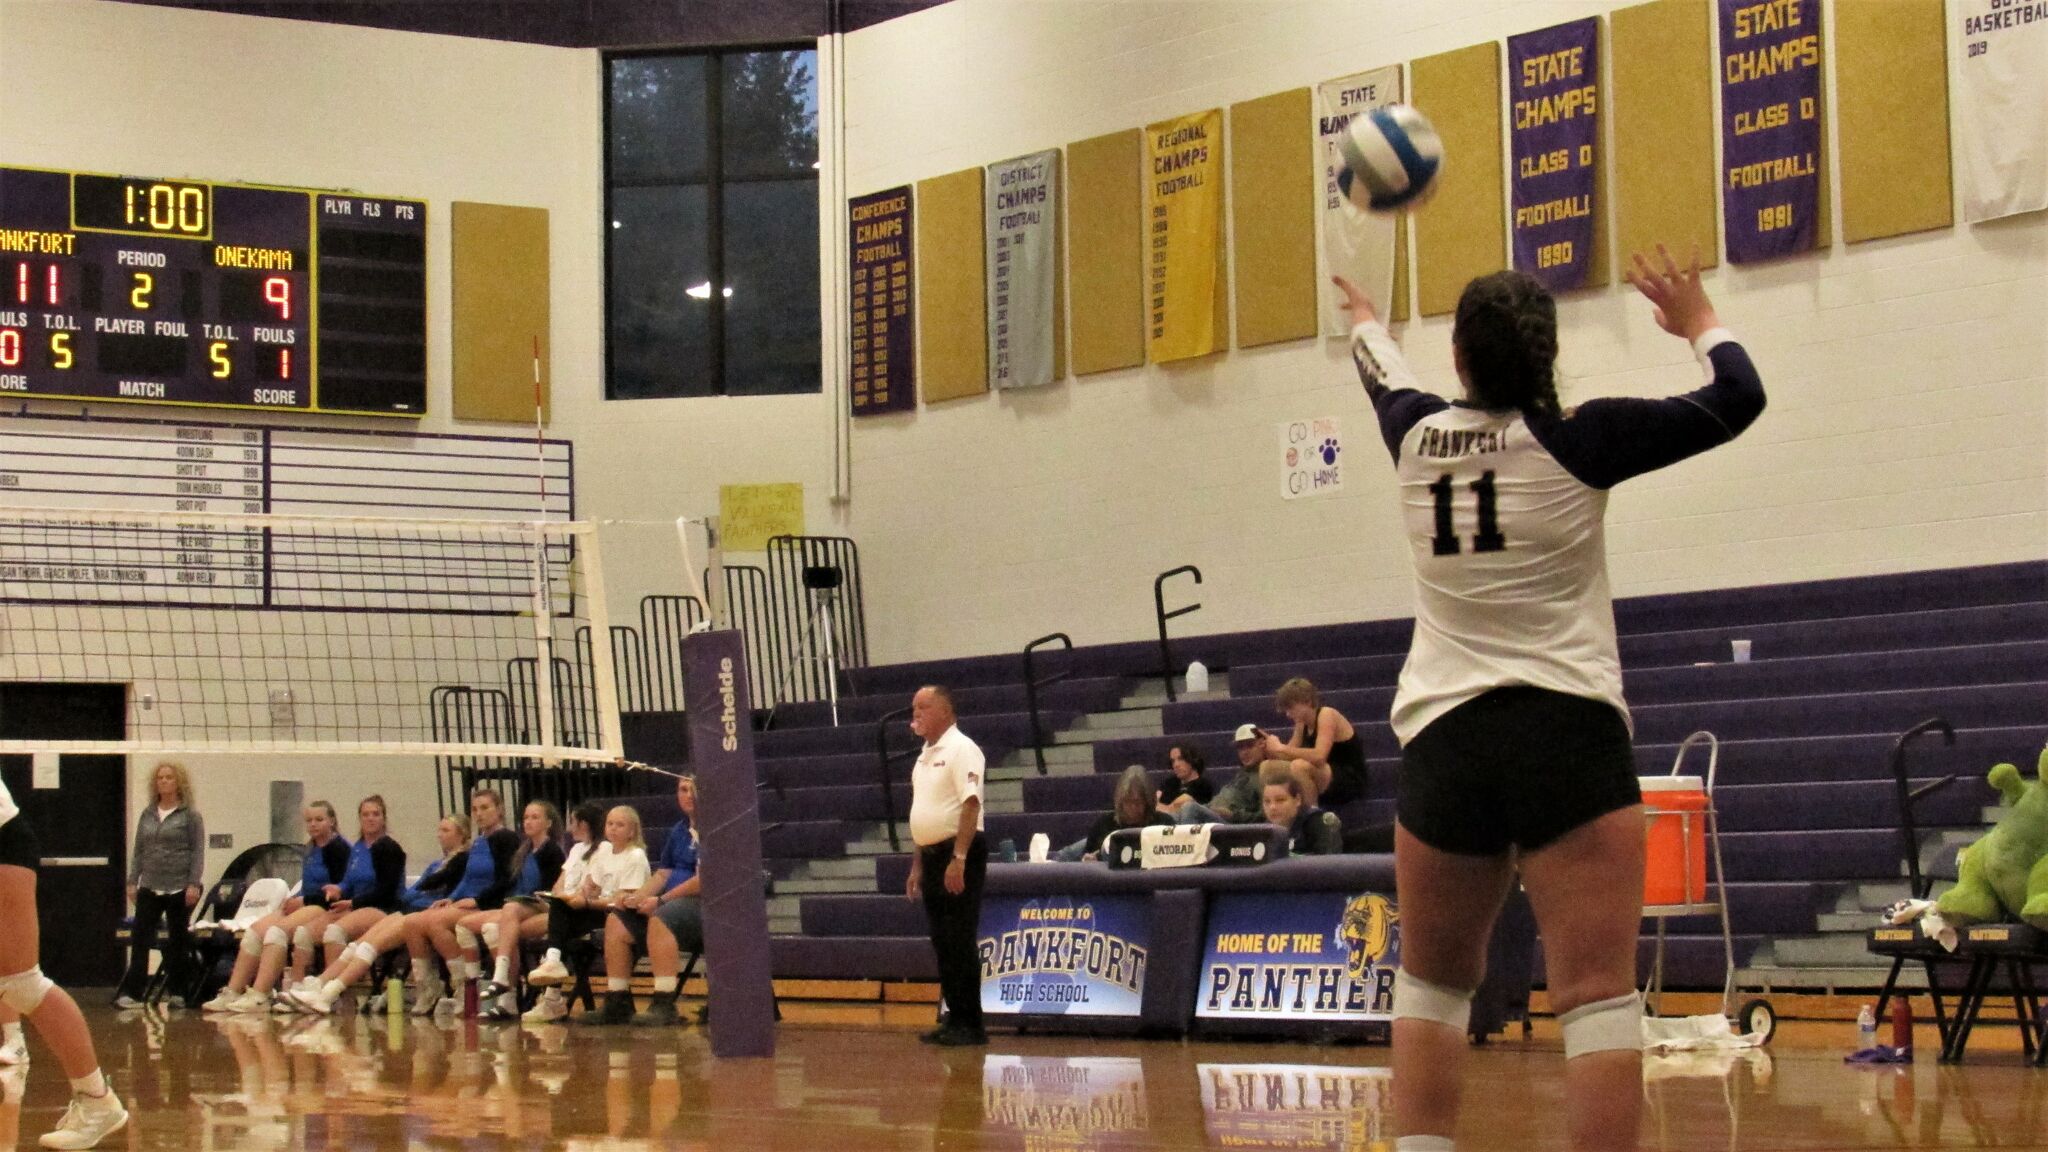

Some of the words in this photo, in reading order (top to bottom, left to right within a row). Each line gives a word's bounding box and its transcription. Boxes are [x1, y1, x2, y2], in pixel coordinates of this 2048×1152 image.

[1735, 0, 1801, 39] STATE
[1523, 47, 1583, 87] STATE
[1726, 35, 1819, 84] CHAMPS
[1341, 85, 1376, 106] STATE
[1515, 85, 1596, 130] CHAMPS
[1735, 103, 1788, 136] CLASS
[1158, 125, 1207, 149] REGIONAL
[1154, 146, 1207, 175] CHAMPS
[1520, 149, 1568, 179] CLASS
[1729, 153, 1814, 190] FOOTBALL
[1001, 165, 1042, 187] DISTRICT
[1157, 171, 1204, 197] FOOTBALL
[126, 185, 203, 231] 1:00
[853, 196, 906, 221] CONFERENCE
[997, 185, 1046, 210] CHAMPS
[325, 200, 351, 215] PLYR
[363, 202, 381, 217] FLS
[395, 205, 414, 220] PTS
[1000, 211, 1040, 230] FOOTBALL
[1516, 195, 1590, 228] FOOTBALL
[1758, 204, 1792, 232] 1991
[857, 218, 902, 243] CHAMPS
[118, 250, 167, 267] PERIOD
[215, 245, 293, 270] ONEKAMA
[857, 241, 901, 263] FOOTBALL
[1537, 241, 1574, 269] 1990
[20, 263, 57, 304] 11
[132, 273, 152, 308] 2
[265, 278, 289, 319] 9
[0, 312, 27, 327] ULS
[44, 314, 81, 330] T.O.L.
[95, 318, 145, 334] PLAYER
[155, 321, 188, 337] FOUL
[203, 324, 239, 341] T.O.L.
[254, 327, 295, 344] FOULS
[0, 330, 20, 365] 0
[52, 333, 72, 369] 5
[210, 343, 230, 377] 5
[281, 349, 289, 379] 1
[119, 381, 165, 397] MATCH
[254, 388, 296, 404] SCORE
[176, 428, 213, 440] WRESTLING
[1289, 422, 1307, 444] GO
[196, 447, 213, 458] DASH
[176, 464, 192, 475] SHOT
[194, 465, 206, 475] PUT
[1289, 470, 1308, 494] GO
[1313, 466, 1340, 489] HOME
[193, 483, 222, 494] HURDLES
[176, 500, 193, 510] SHOT
[194, 501, 206, 511] PUT
[1429, 469, 1507, 556] 11
[176, 536, 192, 547] POLE
[194, 537, 212, 547] VAULT
[176, 554, 192, 565] POLE
[194, 554, 212, 565] VAULT
[44, 568, 65, 579] GRACE
[111, 570, 147, 581] TOWNSEND
[196, 572, 216, 583] RELAY
[719, 657, 738, 752] Schelde
[1152, 844, 1195, 855] GATORAD
[1230, 847, 1251, 857] BONUS
[1020, 907, 1074, 920] WELCOME
[1077, 908, 1091, 920] TO
[1217, 933, 1265, 953] HOME
[1267, 933, 1289, 953] OF
[1292, 933, 1323, 953] THE
[977, 927, 1148, 994] RANKFORT
[1000, 983, 1034, 1001] HIGH
[1038, 984, 1089, 1003] SCHOOL
[1207, 964, 1396, 1013] PANTHER
